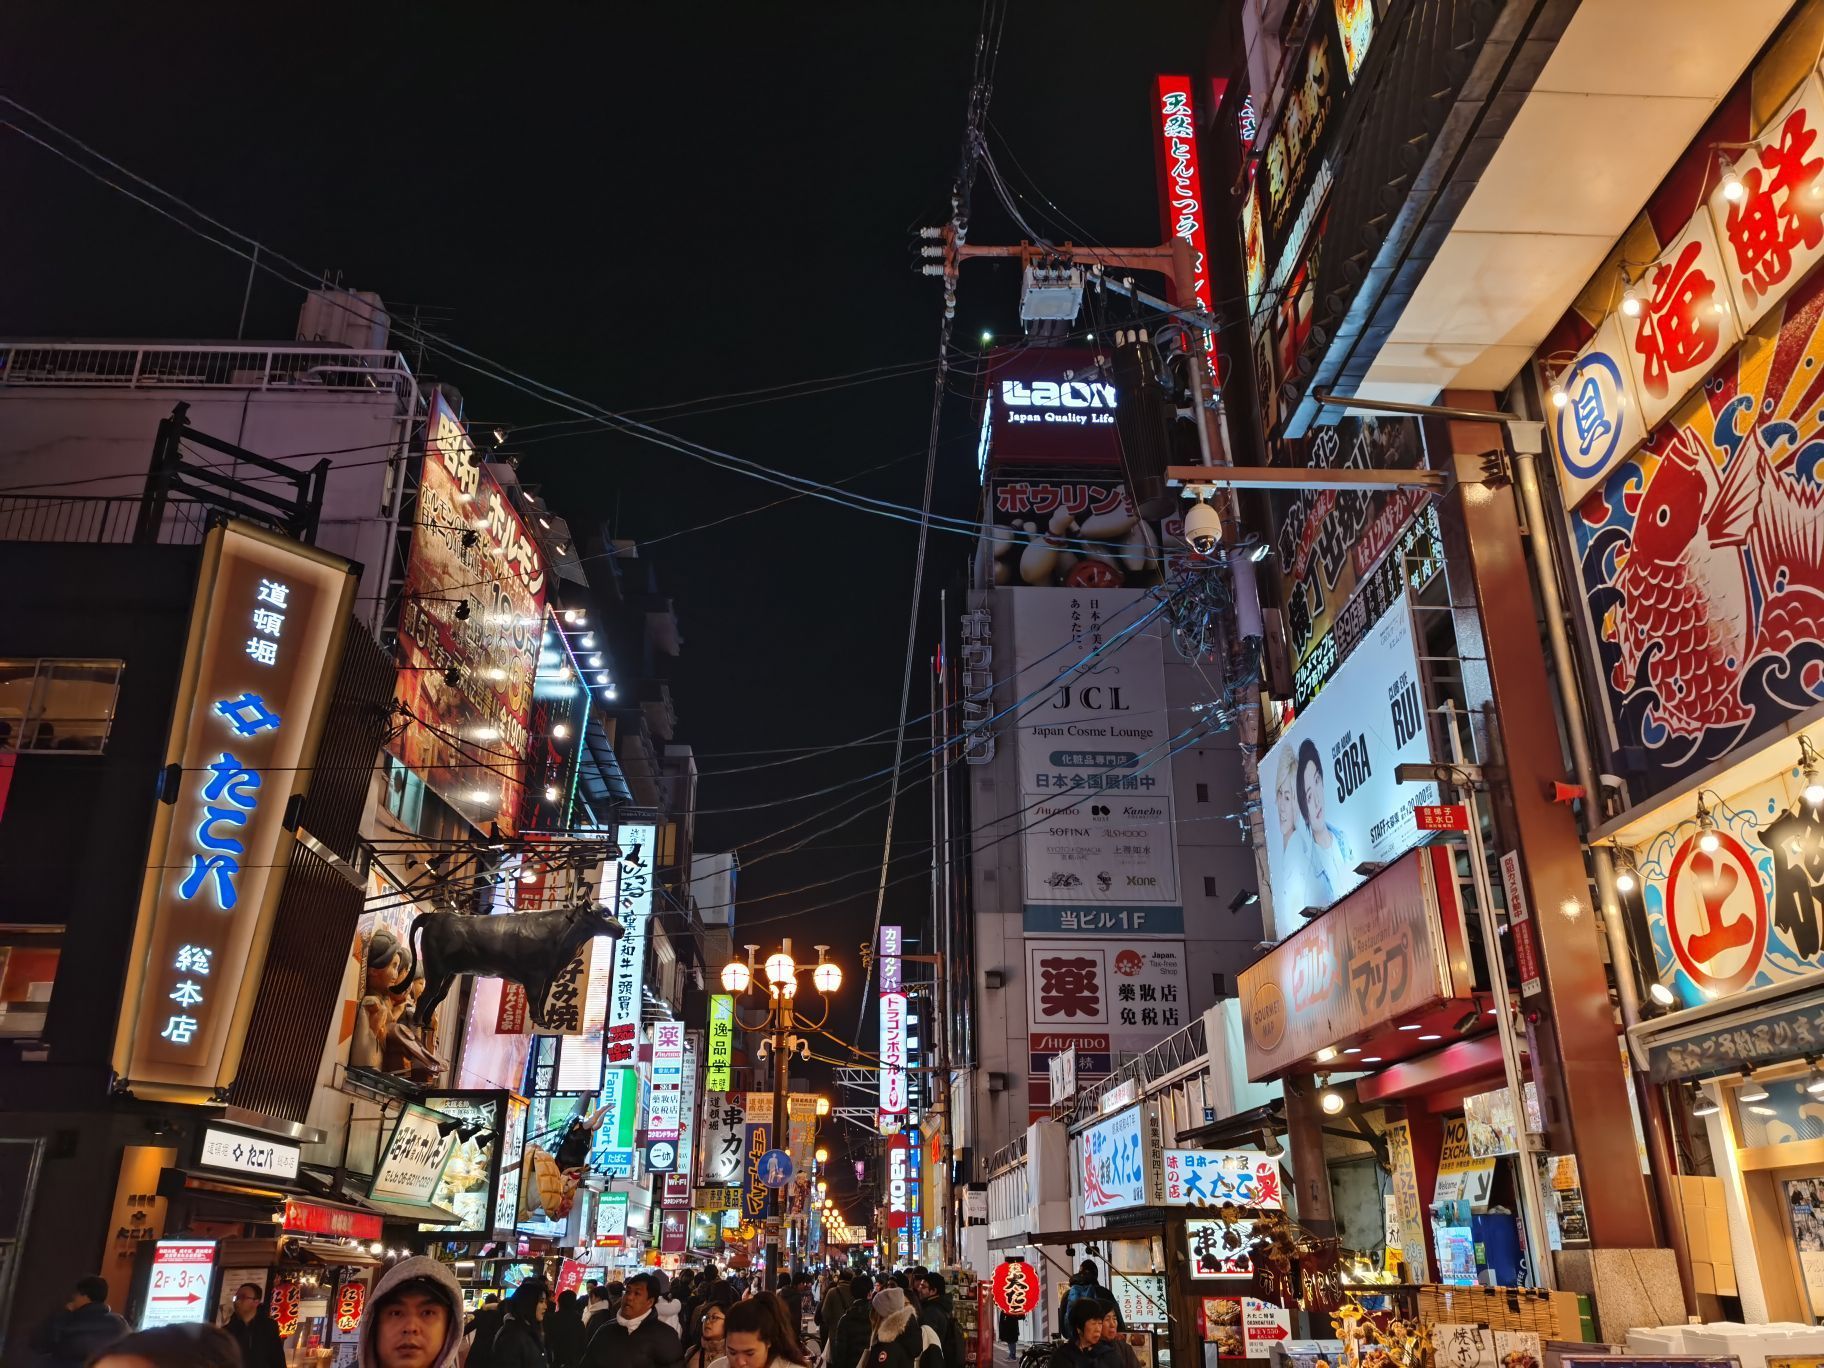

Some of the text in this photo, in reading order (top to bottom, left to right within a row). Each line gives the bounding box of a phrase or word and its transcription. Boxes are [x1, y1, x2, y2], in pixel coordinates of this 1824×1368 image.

[1008, 411, 1114, 424] Japan Quality Life
[997, 483, 1134, 517] ボウリン
[488, 493, 545, 595] ホルモン
[245, 578, 290, 666] 道頓堀
[1070, 599, 1084, 651] あなたに。
[1053, 686, 1130, 710] JCL
[1391, 681, 1423, 752] RUI
[1032, 726, 1153, 740] Japan Cosme Lounge
[1334, 732, 1373, 805] SORA
[1049, 828, 1091, 837] SOFINA
[1060, 910, 1147, 930] 当ビル1F
[161, 944, 213, 1045] 総本店
[1040, 957, 1100, 1018] 薬
[1160, 968, 1178, 976] Shop
[1351, 938, 1410, 1016] マップ
[658, 1025, 680, 1047] 薬
[712, 1022, 728, 1074] 逸品堂
[1035, 1035, 1106, 1049] SHISEIDO
[708, 1096, 721, 1131] 道頓堀
[720, 1105, 745, 1178] 串カツ
[1111, 1132, 1142, 1186] 大たこ
[1149, 1118, 1164, 1201] 創業昭和四十七年
[1184, 1155, 1218, 1167] 日本一
[1166, 1156, 1181, 1199] 味の店
[1182, 1169, 1254, 1200] 大たこ
[1396, 1125, 1420, 1231] MONEY
